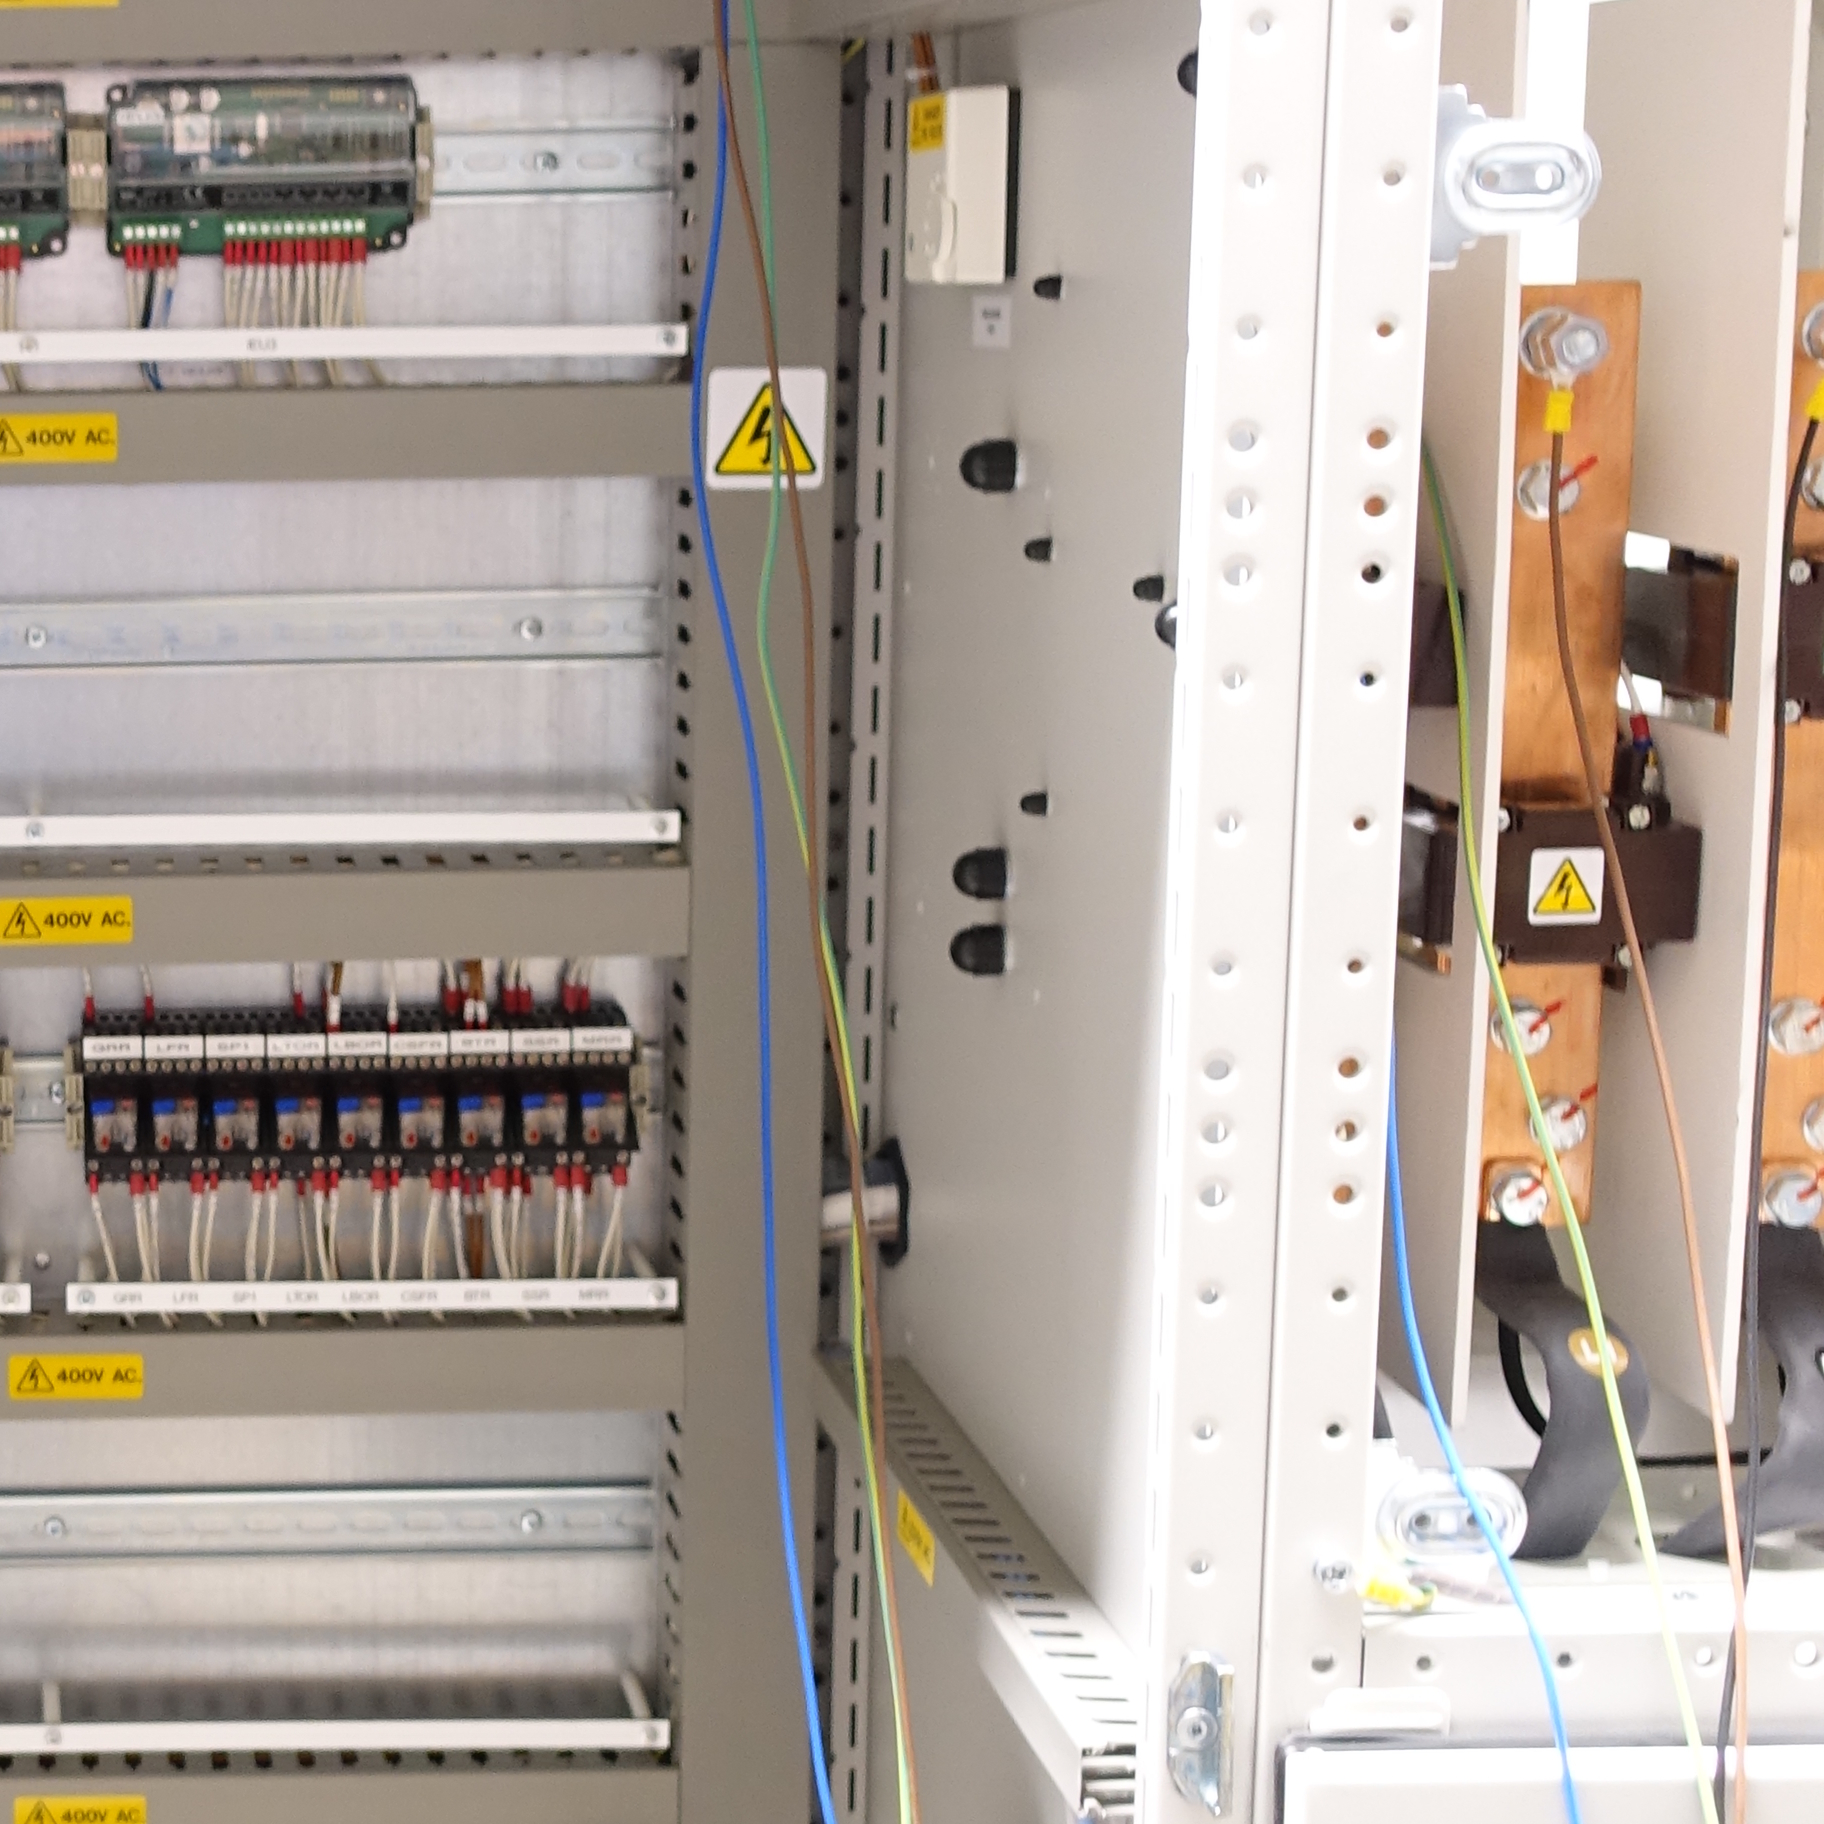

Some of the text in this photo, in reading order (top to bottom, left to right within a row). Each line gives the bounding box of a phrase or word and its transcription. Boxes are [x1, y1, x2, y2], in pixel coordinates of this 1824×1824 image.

[25, 430, 77, 446] 400V
[43, 913, 93, 928] 400V
[57, 1369, 105, 1384] 400V
[61, 1810, 108, 1824] 400V
